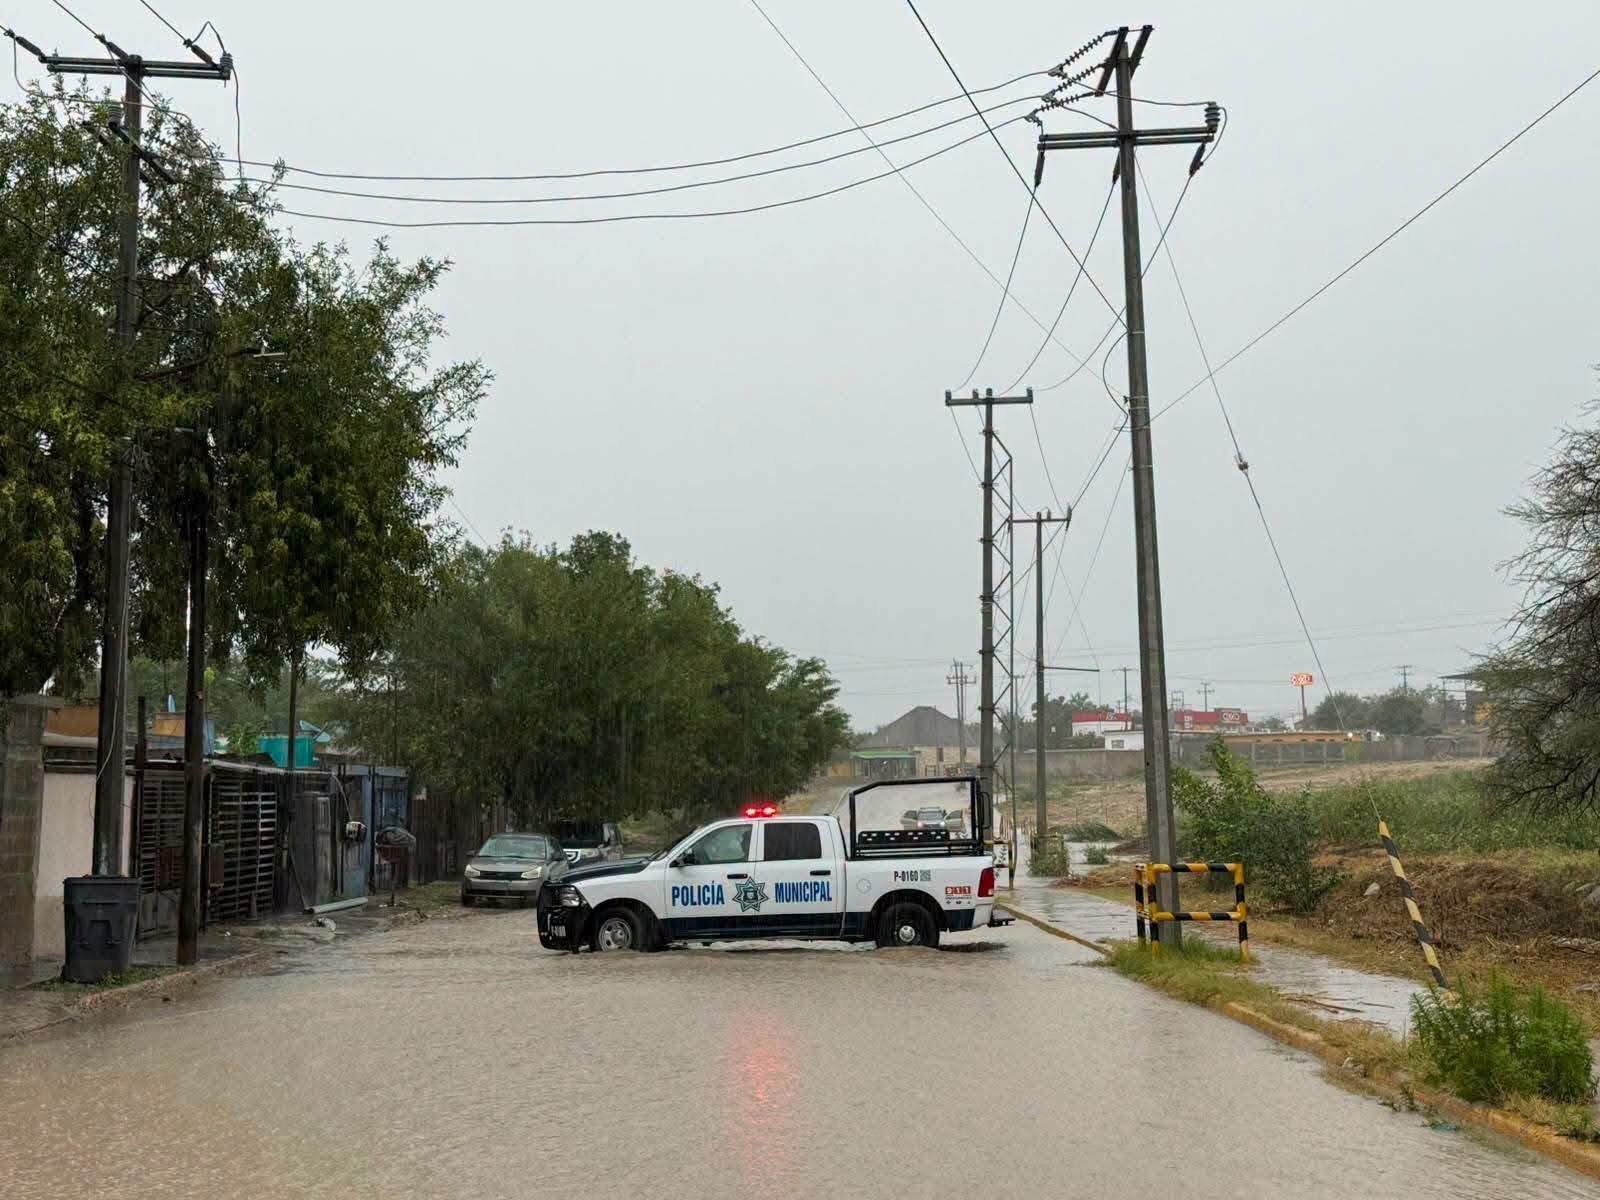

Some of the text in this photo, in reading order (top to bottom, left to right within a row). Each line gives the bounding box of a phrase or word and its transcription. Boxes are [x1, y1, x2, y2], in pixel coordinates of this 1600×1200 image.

[894, 870, 918, 882] P-0160
[671, 880, 833, 906] POLICÍA MUNICIPAL
